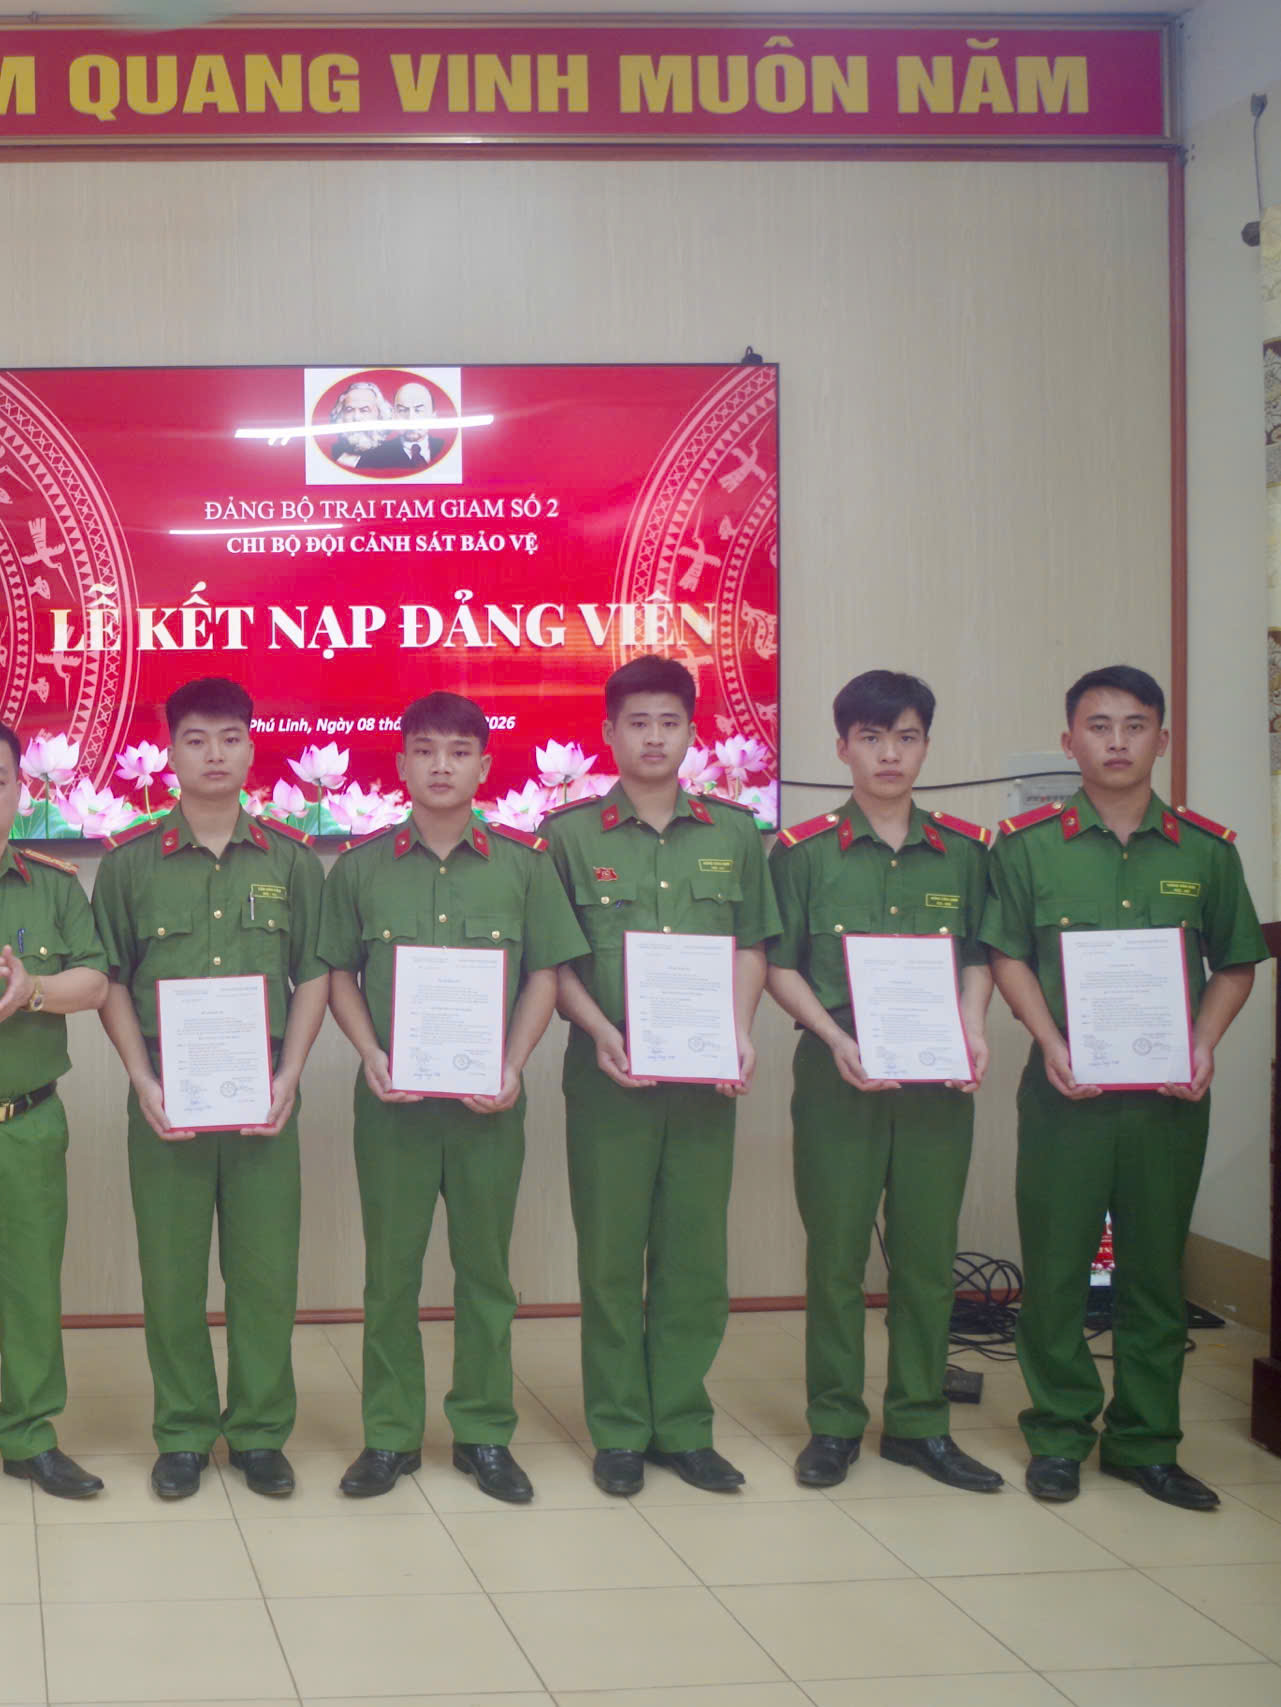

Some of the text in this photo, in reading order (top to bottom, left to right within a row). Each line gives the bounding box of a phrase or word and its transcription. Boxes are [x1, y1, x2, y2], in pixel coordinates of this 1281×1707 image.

[69, 53, 360, 121] QUANG
[390, 54, 588, 113] VINH
[620, 35, 868, 114] MUÔN
[897, 37, 1089, 115] NĂM
[204, 493, 560, 522] ĐẢNG BỘ TRẠI TẠM GIAM SỐ 2
[226, 529, 538, 557] CHI BỘ ĐỘI CẢNH SÁT BẢO VỆ
[50, 581, 716, 660] LỄ KẾT NẠP ĐẢNG VIÊN
[250, 717, 275, 732] Phú
[278, 717, 312, 734] Linh,
[316, 718, 354, 735] Ngày
[357, 717, 375, 731] 08
[378, 716, 402, 731] thá
